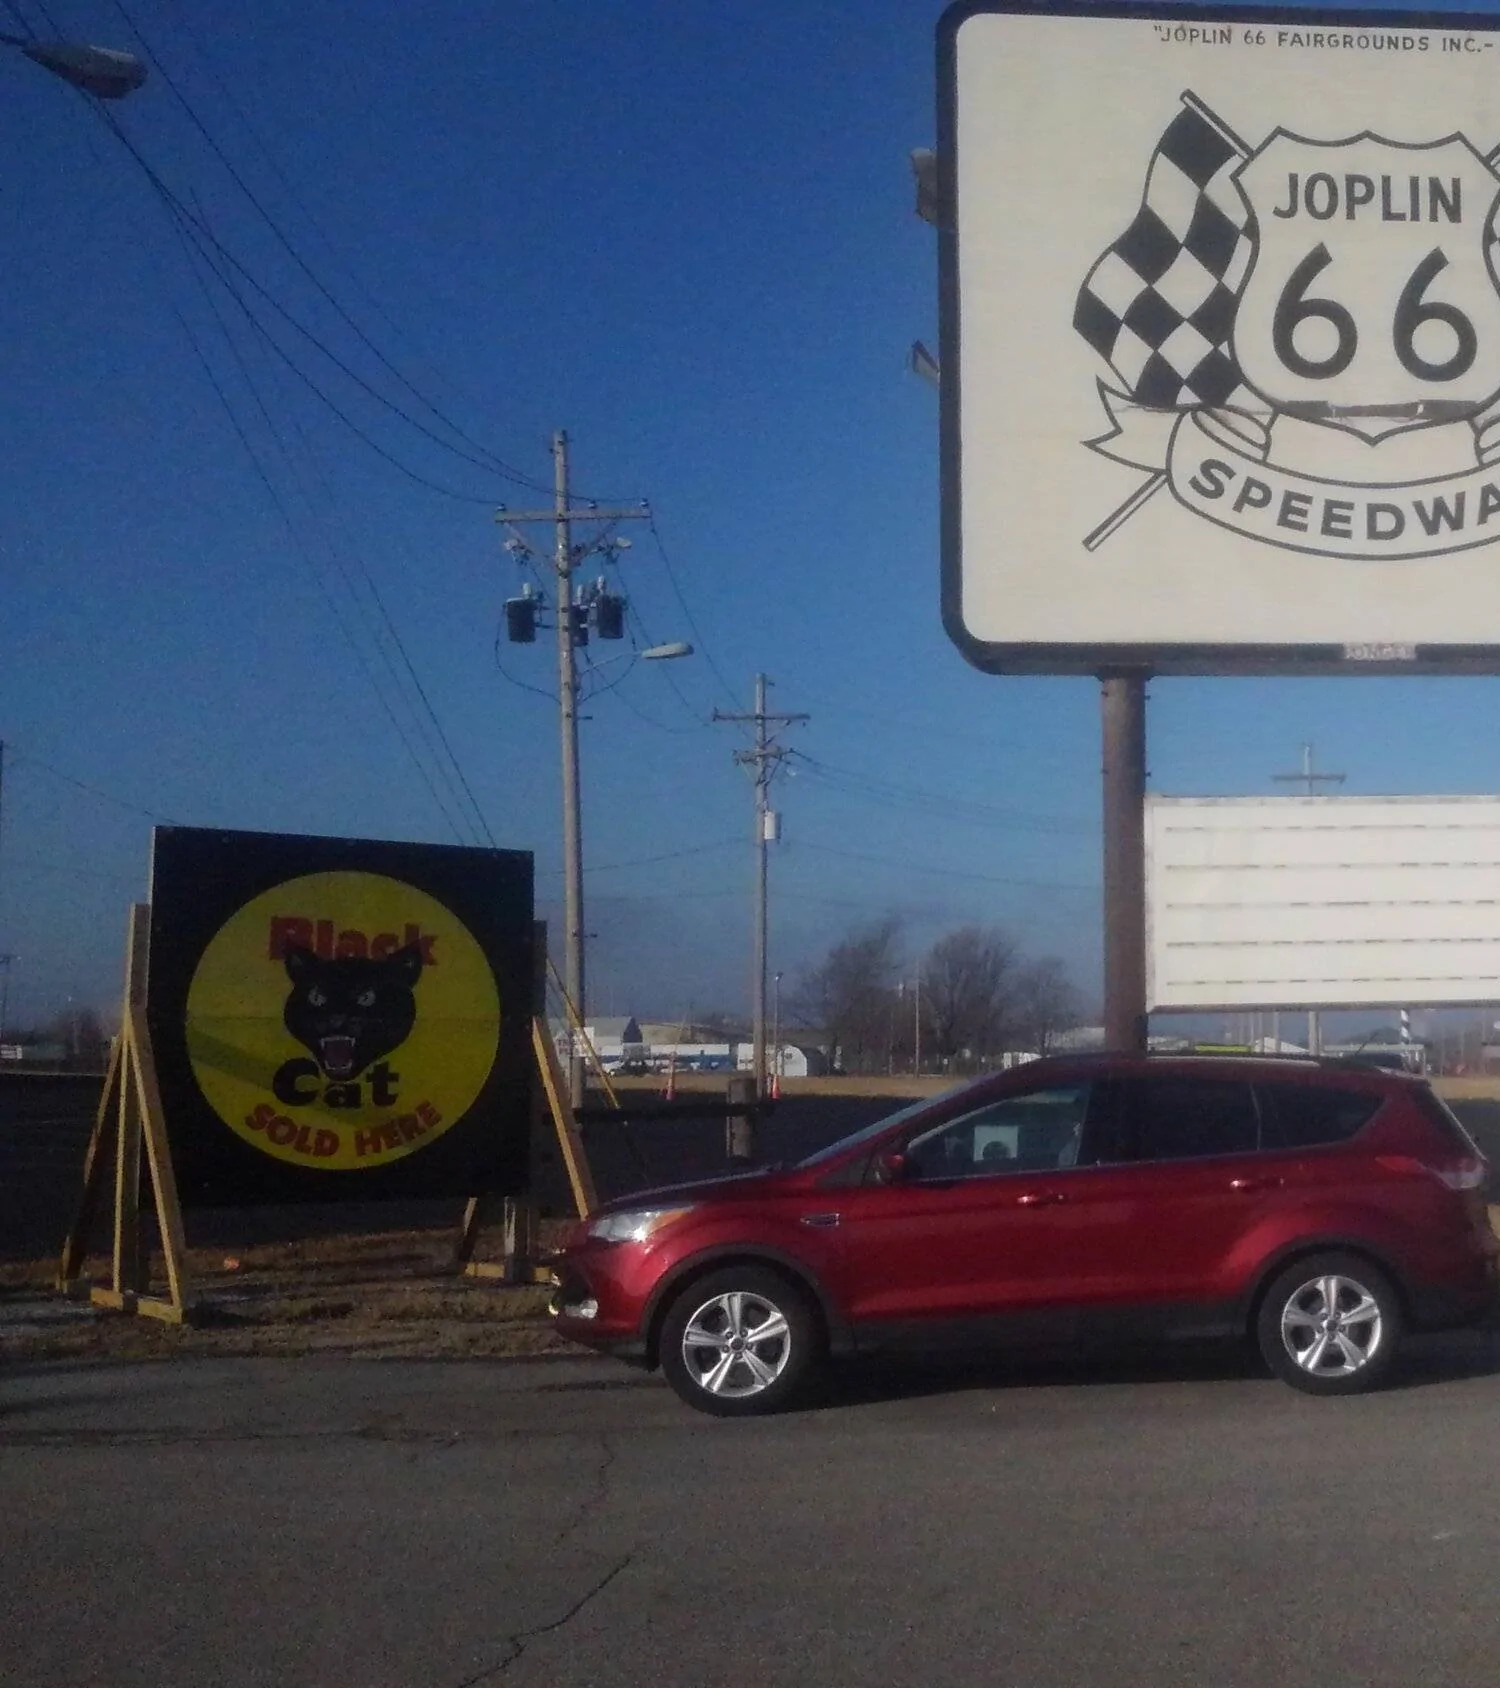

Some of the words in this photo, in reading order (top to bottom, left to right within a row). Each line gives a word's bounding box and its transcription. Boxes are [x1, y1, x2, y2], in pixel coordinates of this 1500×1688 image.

[1243, 30, 1266, 46] 66
[1278, 32, 1430, 52] FAIRGROUNDS
[1273, 173, 1462, 223] JOPLIN
[1272, 242, 1478, 383] 66
[269, 916, 439, 967] Black
[272, 1057, 398, 1109] Cat
[246, 1104, 340, 1157] SOLD
[355, 1101, 442, 1156] HERE
